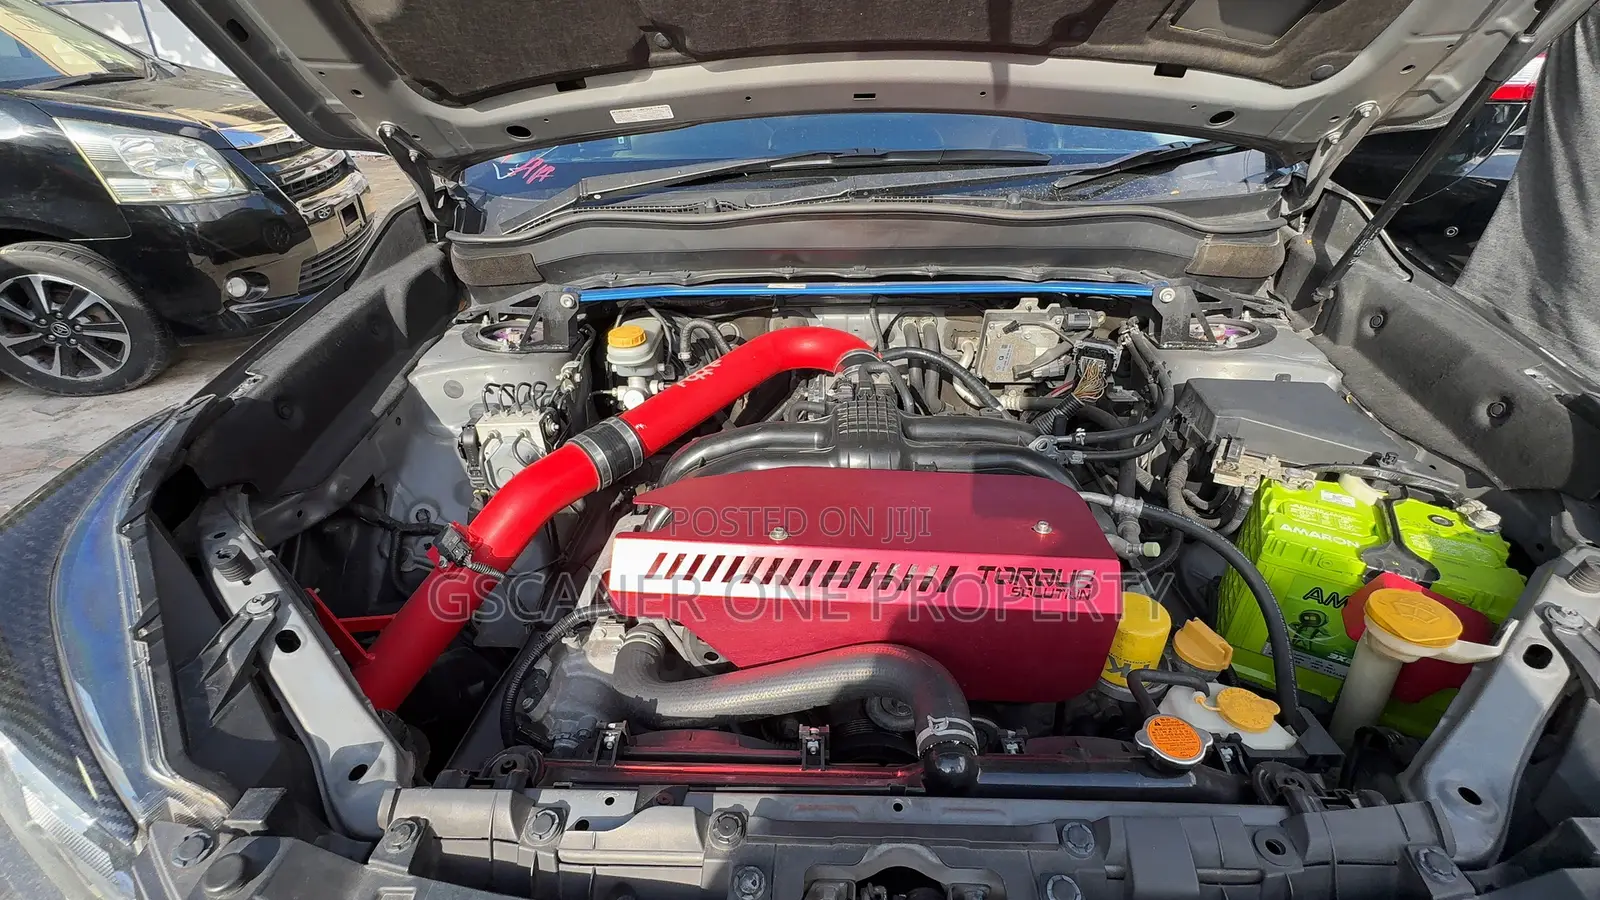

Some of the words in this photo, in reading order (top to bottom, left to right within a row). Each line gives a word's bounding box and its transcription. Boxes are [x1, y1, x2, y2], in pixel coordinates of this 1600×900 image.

[1280, 523, 1360, 548] AMARON
[977, 565, 1096, 588] TORQUE
[1010, 586, 1092, 600] SOLUTION
